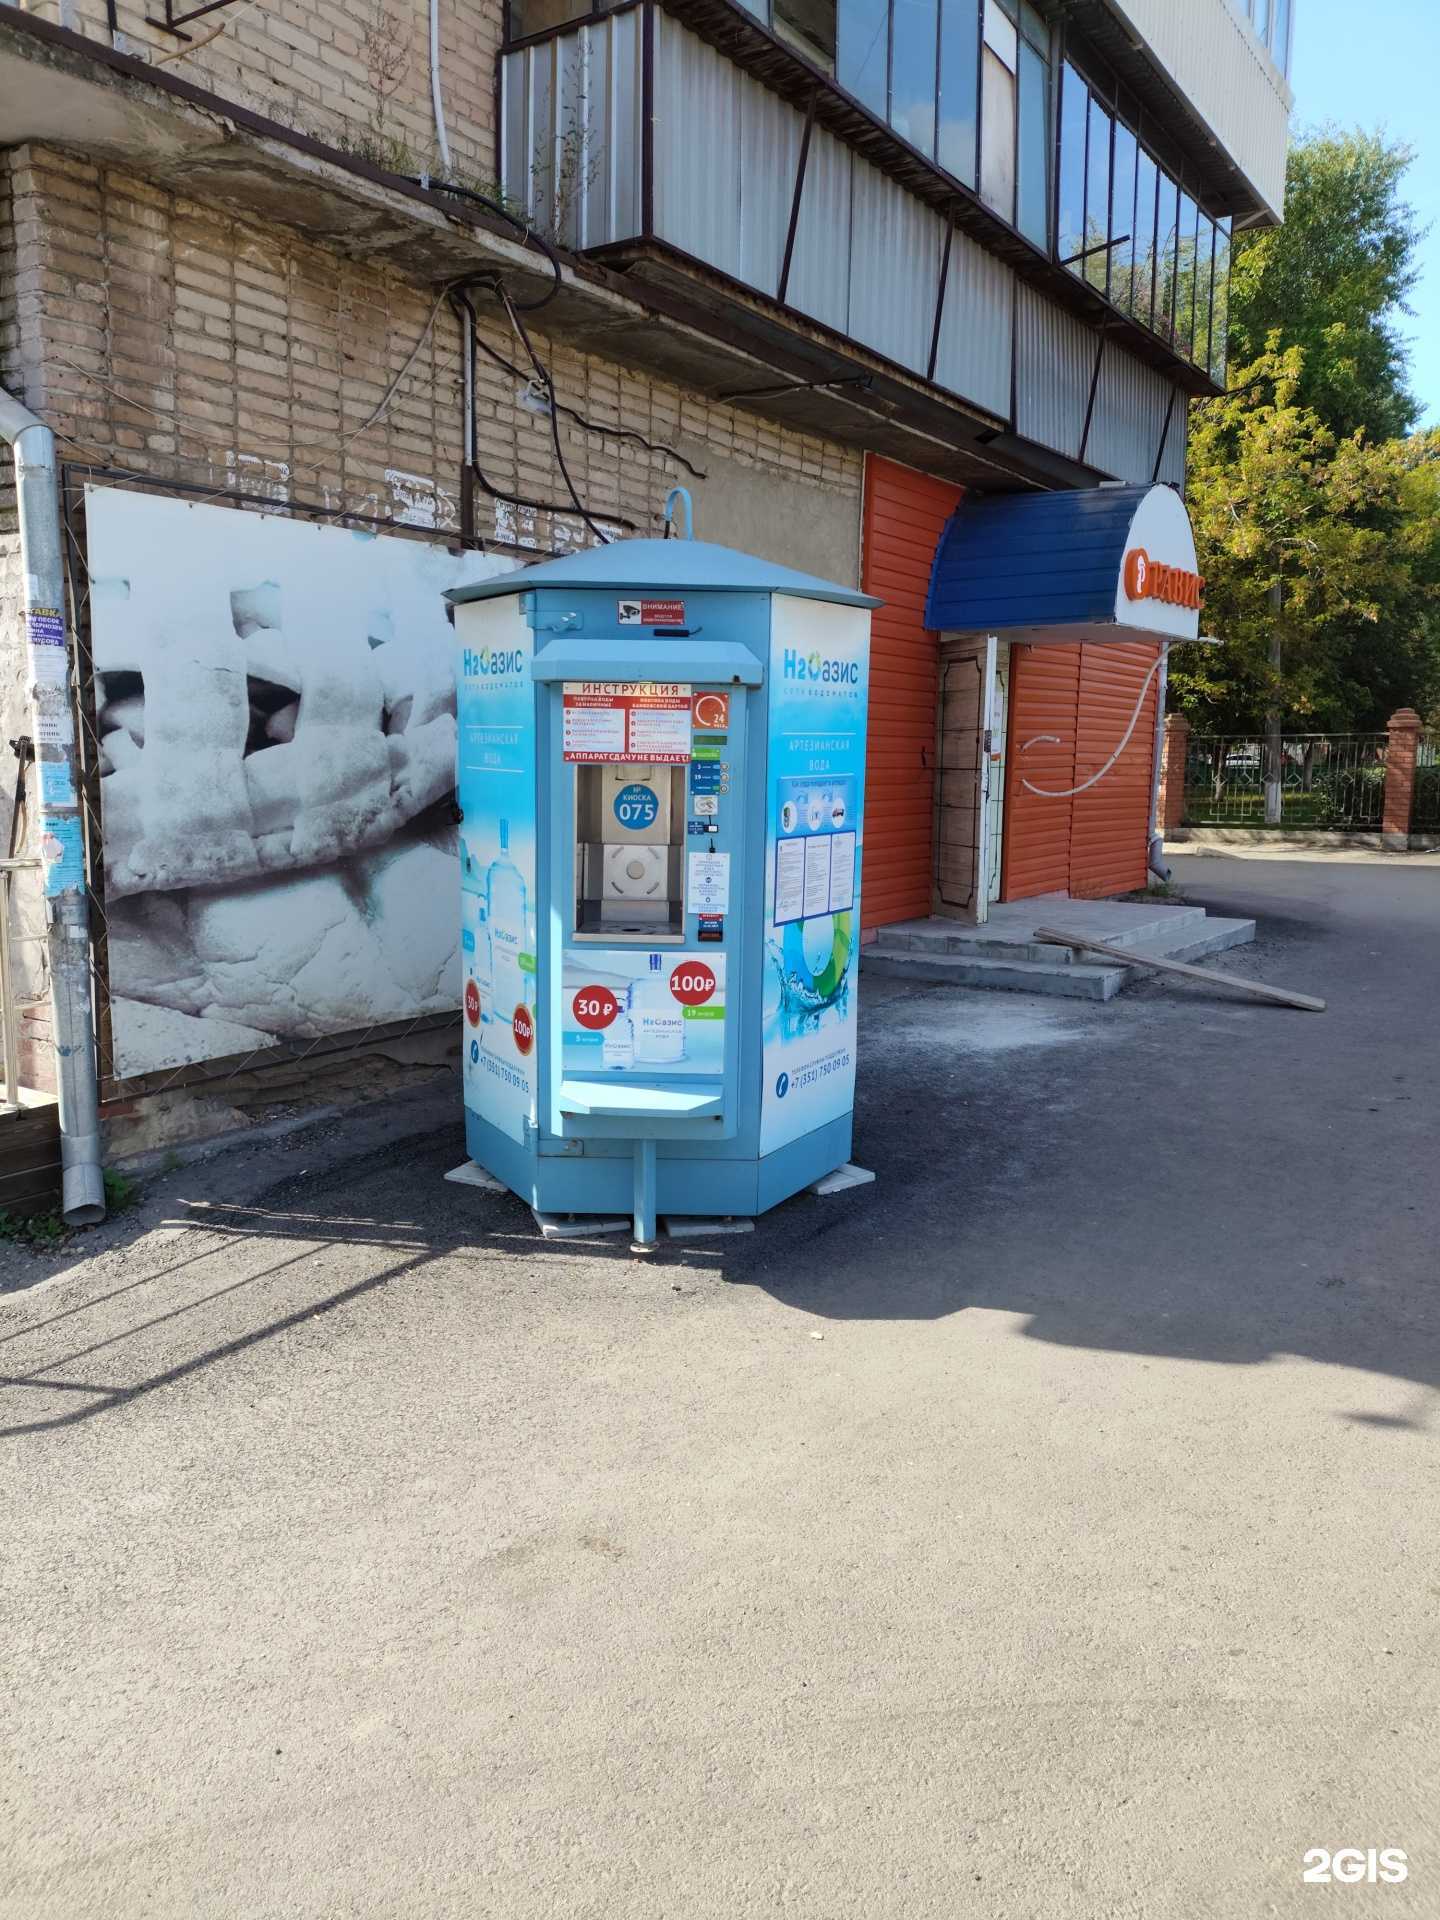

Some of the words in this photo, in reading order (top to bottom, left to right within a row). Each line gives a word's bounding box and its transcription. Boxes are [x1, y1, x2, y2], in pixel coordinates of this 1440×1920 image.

[582, 684, 679, 696] ИНСТРУКЦИЯ
[713, 713, 724, 723] 24
[570, 752, 608, 760] АППАРАТ
[609, 753, 637, 761] СДАЧУ
[809, 760, 830, 771] ВОДА
[620, 804, 654, 820] 075
[577, 999, 600, 1015] 30
[687, 1008, 696, 1016] 19
